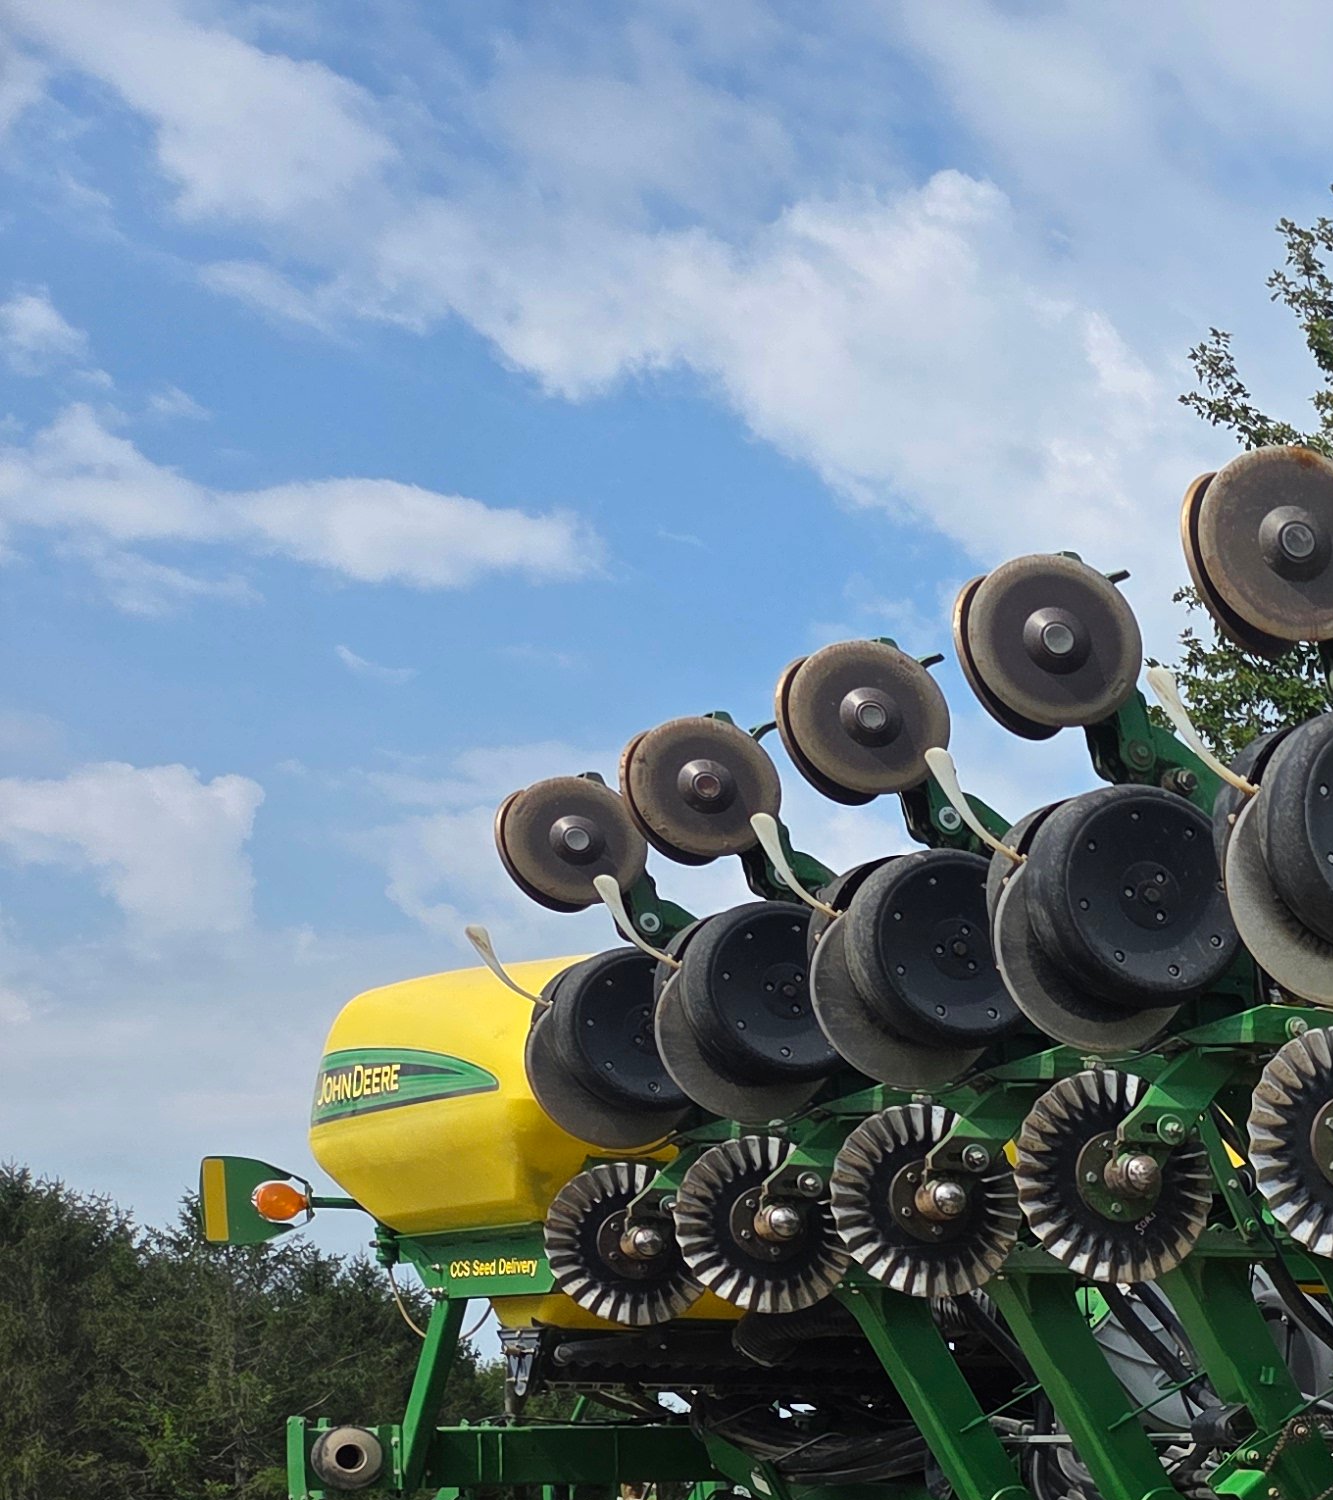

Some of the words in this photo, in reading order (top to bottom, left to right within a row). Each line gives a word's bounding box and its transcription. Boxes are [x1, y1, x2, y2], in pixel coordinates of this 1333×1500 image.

[317, 1072, 352, 1106] JOHN
[352, 1063, 401, 1098] DEERE
[450, 1260, 471, 1278] CCS
[472, 1259, 496, 1276] Seed
[498, 1257, 538, 1277] Delivery
